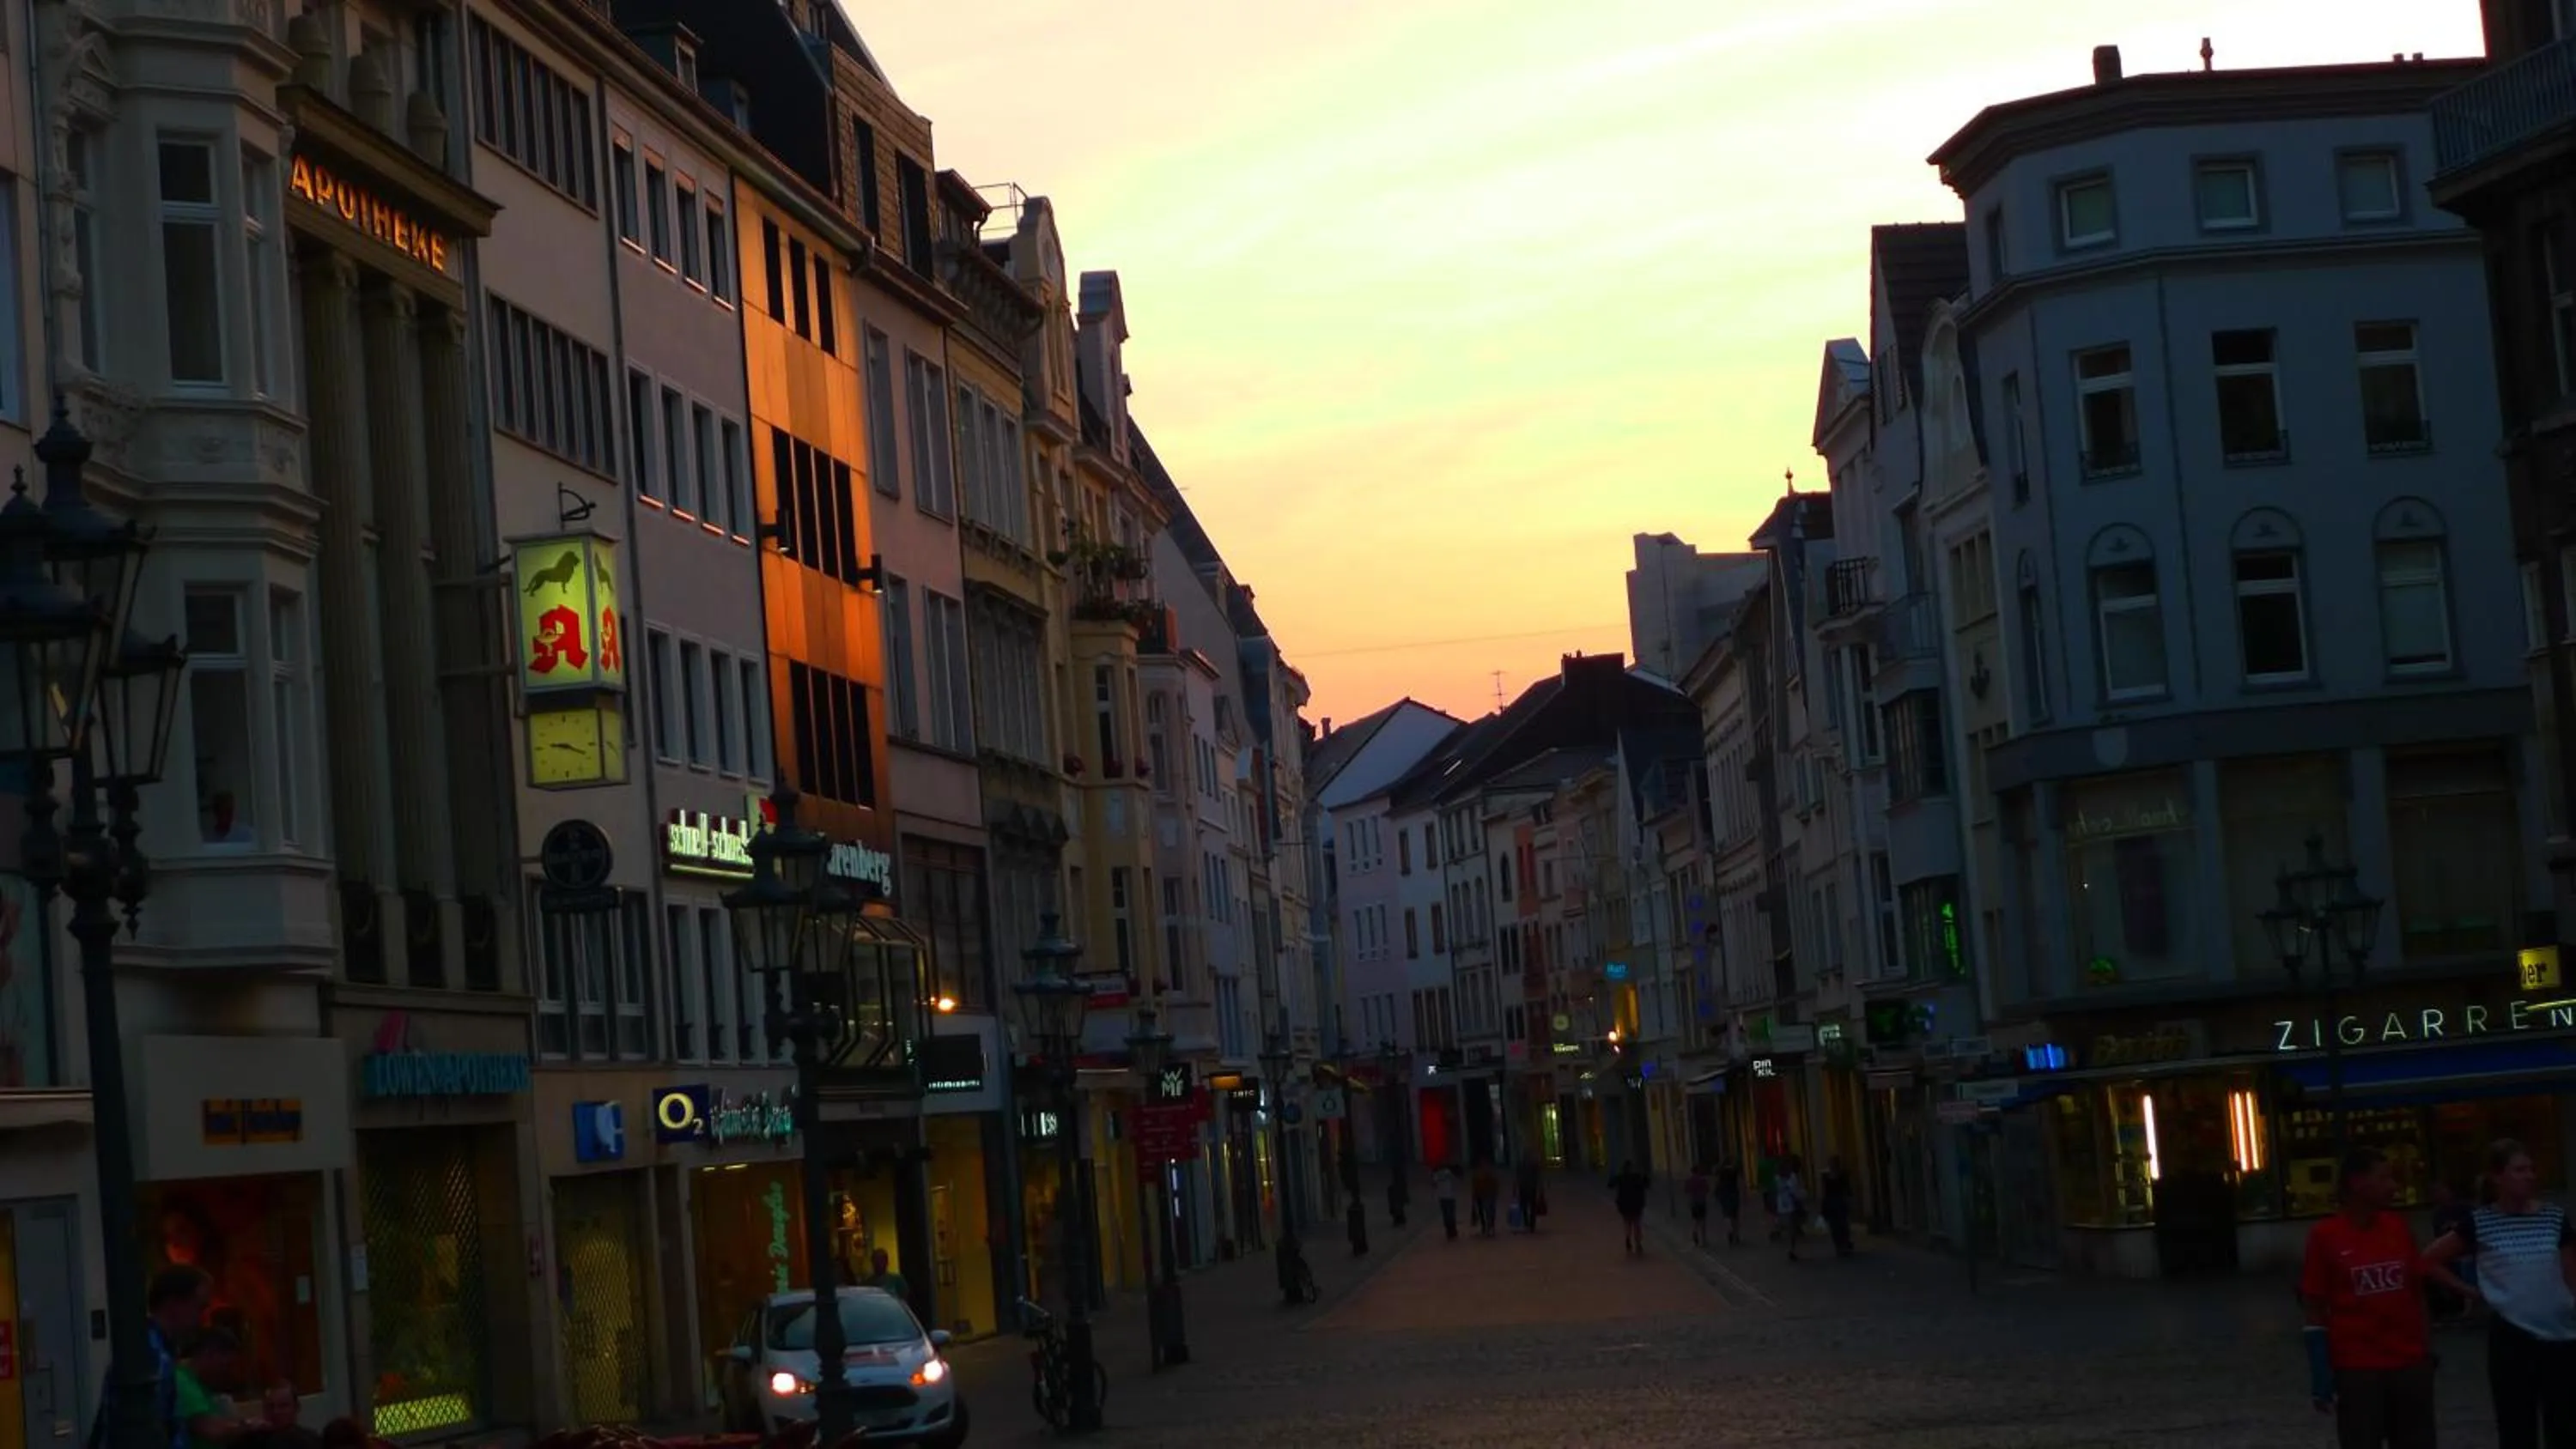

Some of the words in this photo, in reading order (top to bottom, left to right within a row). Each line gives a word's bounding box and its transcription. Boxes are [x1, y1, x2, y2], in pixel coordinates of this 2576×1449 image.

[289, 152, 449, 274] APOTHEKE
[2274, 999, 2575, 1052] ZIGARREN
[2357, 1264, 2403, 1290] AIG
